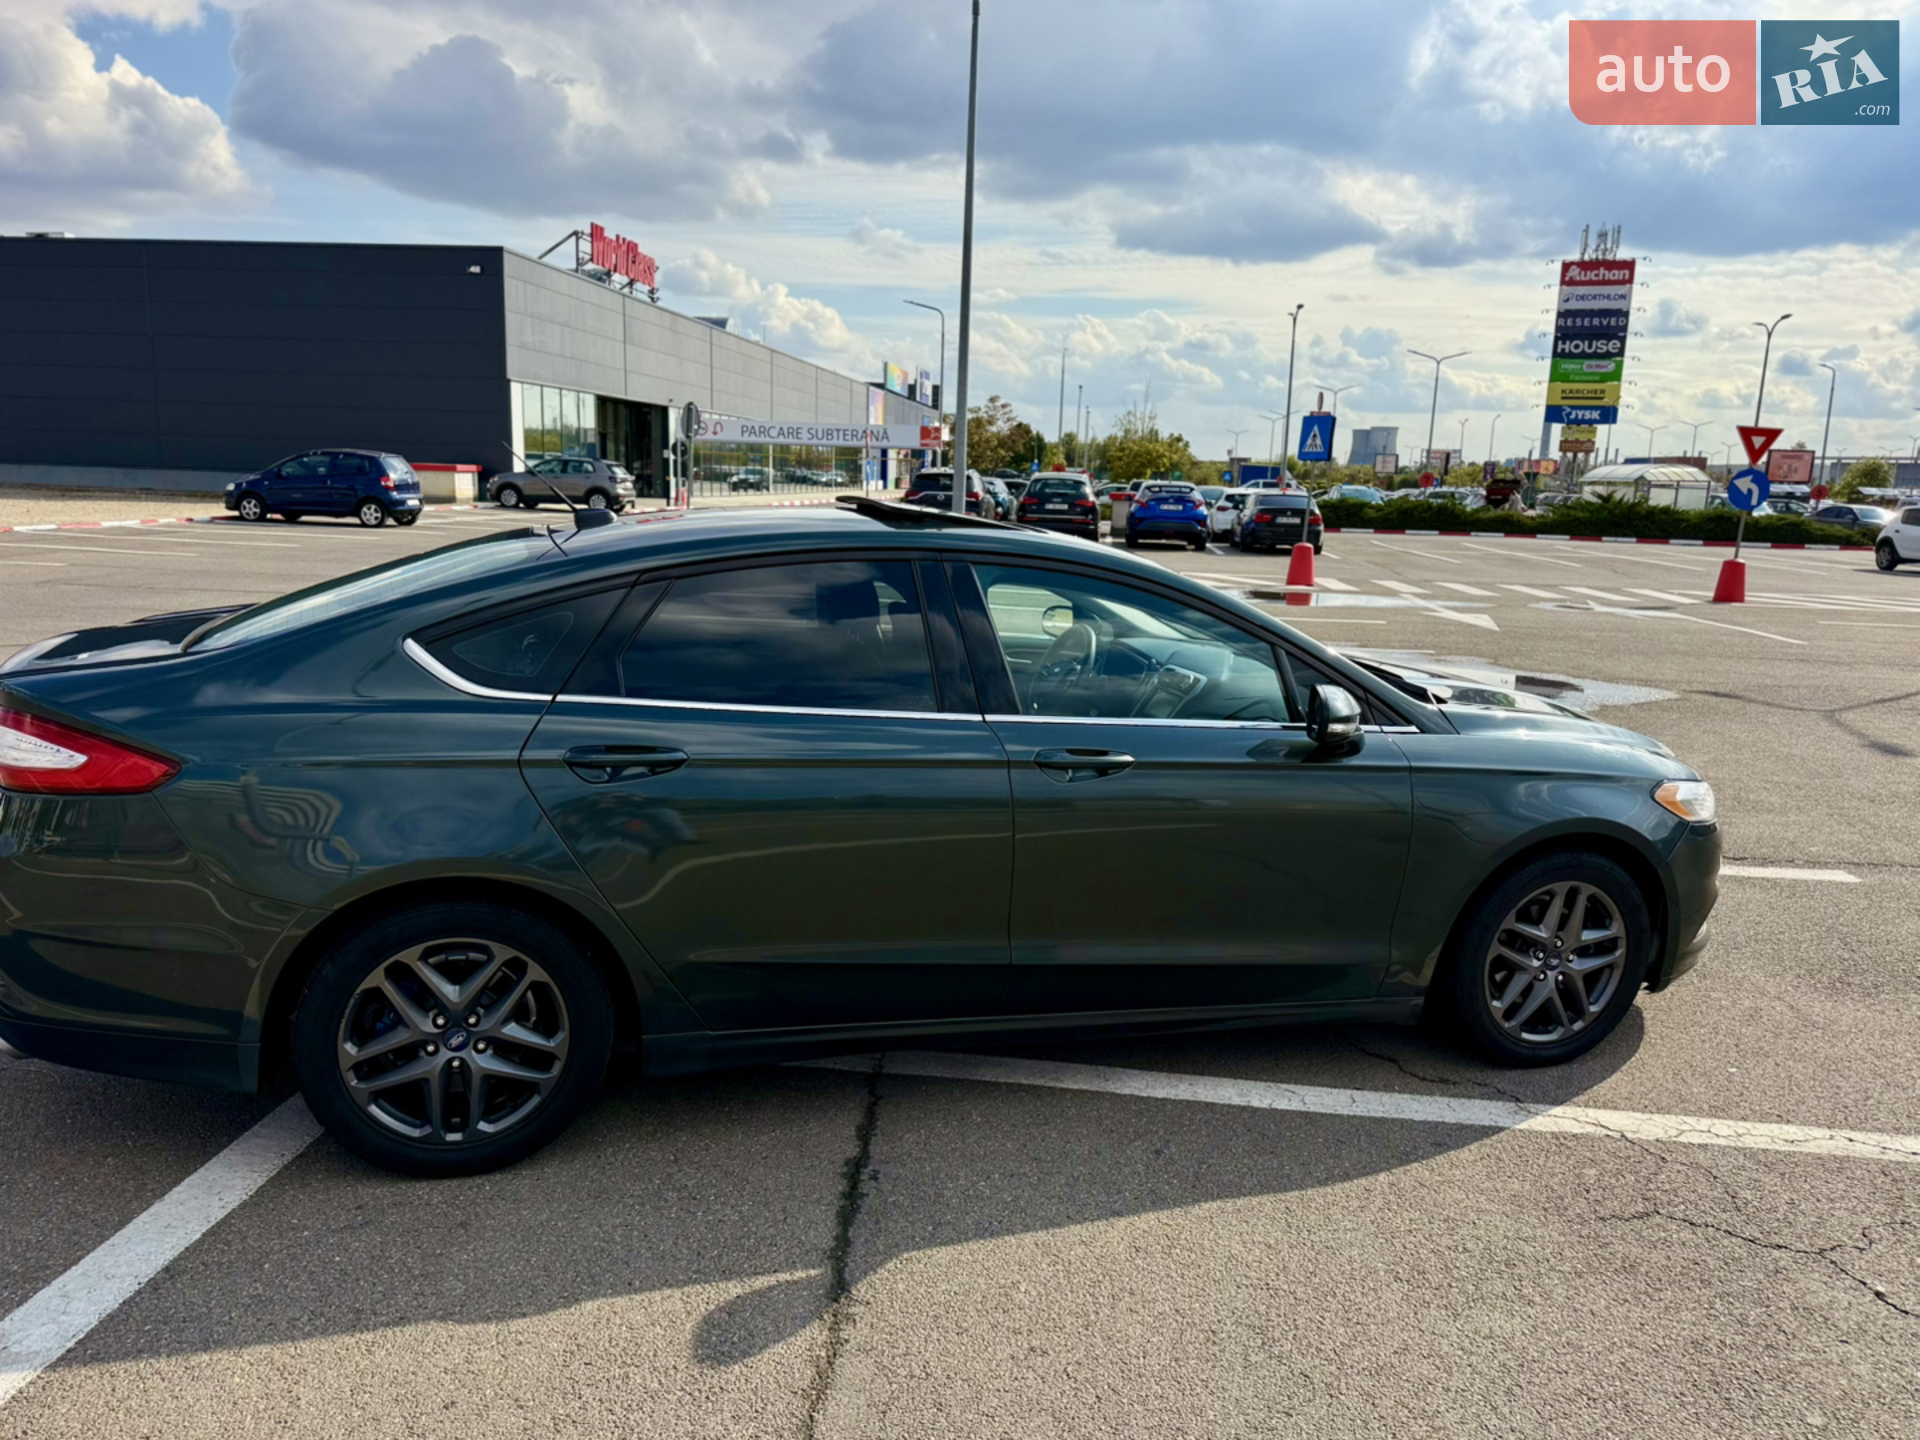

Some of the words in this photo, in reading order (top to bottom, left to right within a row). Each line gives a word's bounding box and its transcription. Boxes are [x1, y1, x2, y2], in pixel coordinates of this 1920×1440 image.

[1564, 264, 1630, 281] Auchan
[1557, 317, 1627, 327] RESERVED
[1569, 409, 1601, 420] JYSK
[740, 424, 804, 441] PARCARE
